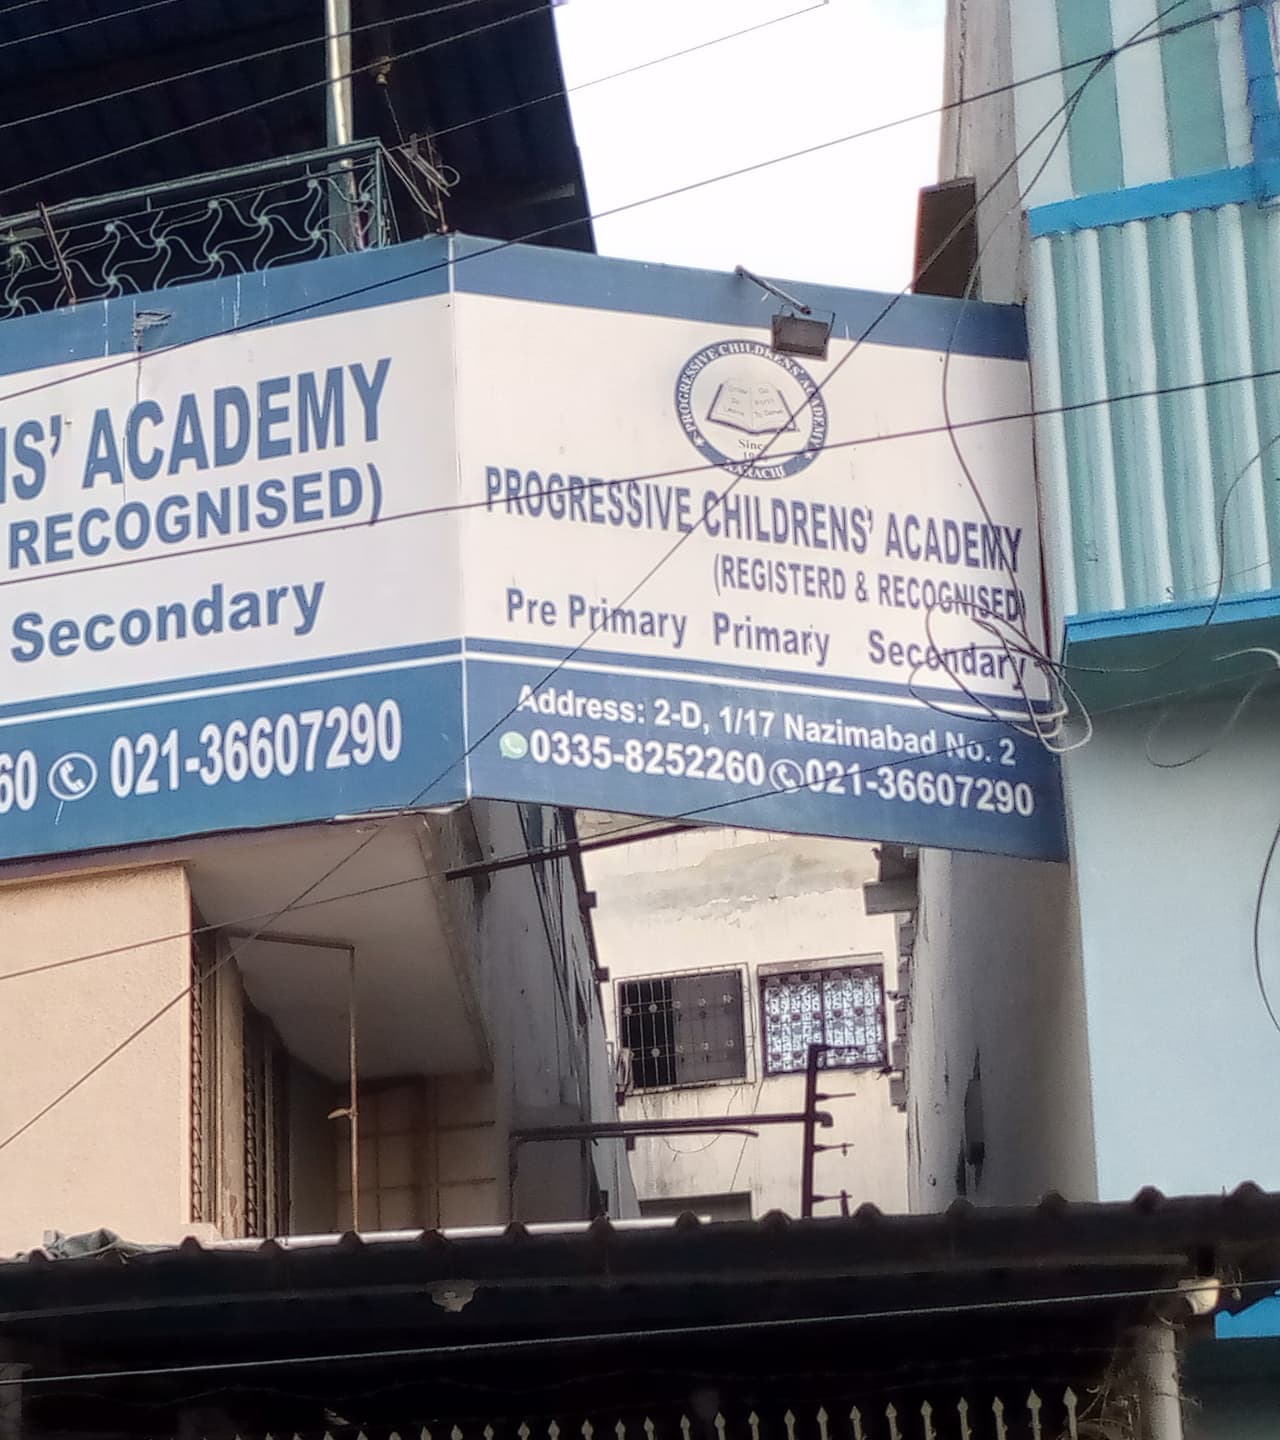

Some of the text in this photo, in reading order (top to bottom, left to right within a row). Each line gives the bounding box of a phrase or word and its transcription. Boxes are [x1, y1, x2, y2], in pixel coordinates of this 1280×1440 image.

[82, 358, 392, 489] ACADEMY
[678, 348, 718, 431] PROGRESSIVE
[9, 463, 383, 570] RECOGNISED)
[485, 466, 692, 533] PROGRESSIVE
[885, 512, 1023, 573] ACADEMY
[10, 581, 326, 663] Secondary
[714, 553, 1025, 622] (REGISTERD & RECOGNISED)
[506, 588, 1026, 691] Pre Primary Primary Secondary
[109, 699, 402, 797] 021-36607290
[516, 685, 1017, 767] Address: 2-D, 1/17 Nazimabad No. 2
[530, 729, 1035, 817] 0335-8252260 021-36607290
